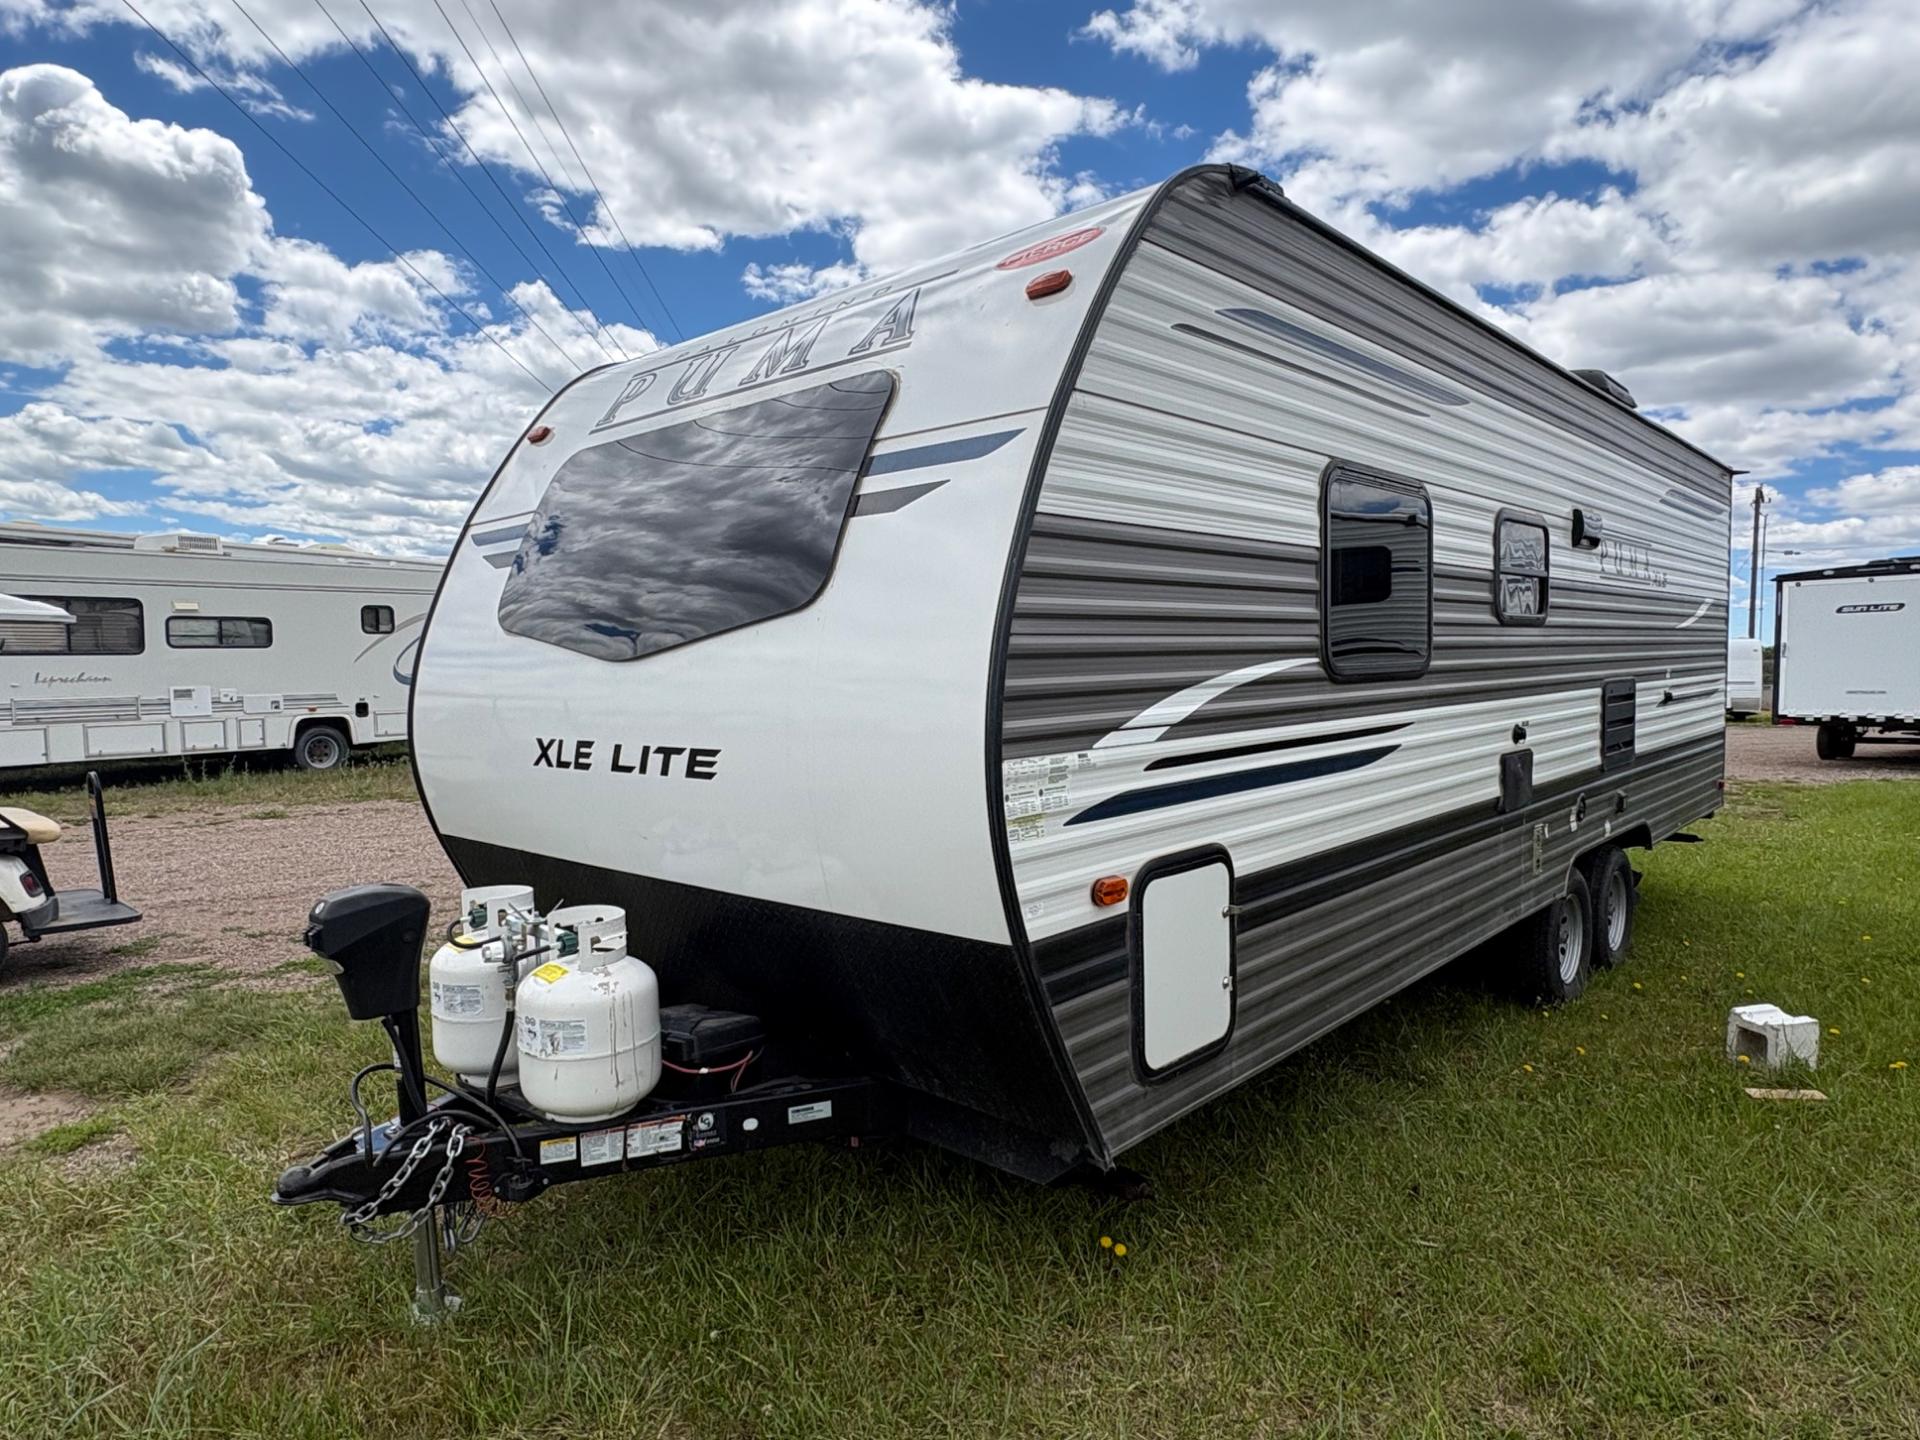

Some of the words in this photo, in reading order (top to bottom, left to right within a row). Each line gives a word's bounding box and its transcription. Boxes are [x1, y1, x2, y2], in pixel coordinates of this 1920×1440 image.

[595, 287, 921, 427] PUMA
[1869, 603, 1900, 612] LITE
[533, 737, 595, 771] XLE
[611, 743, 722, 780] LITE
